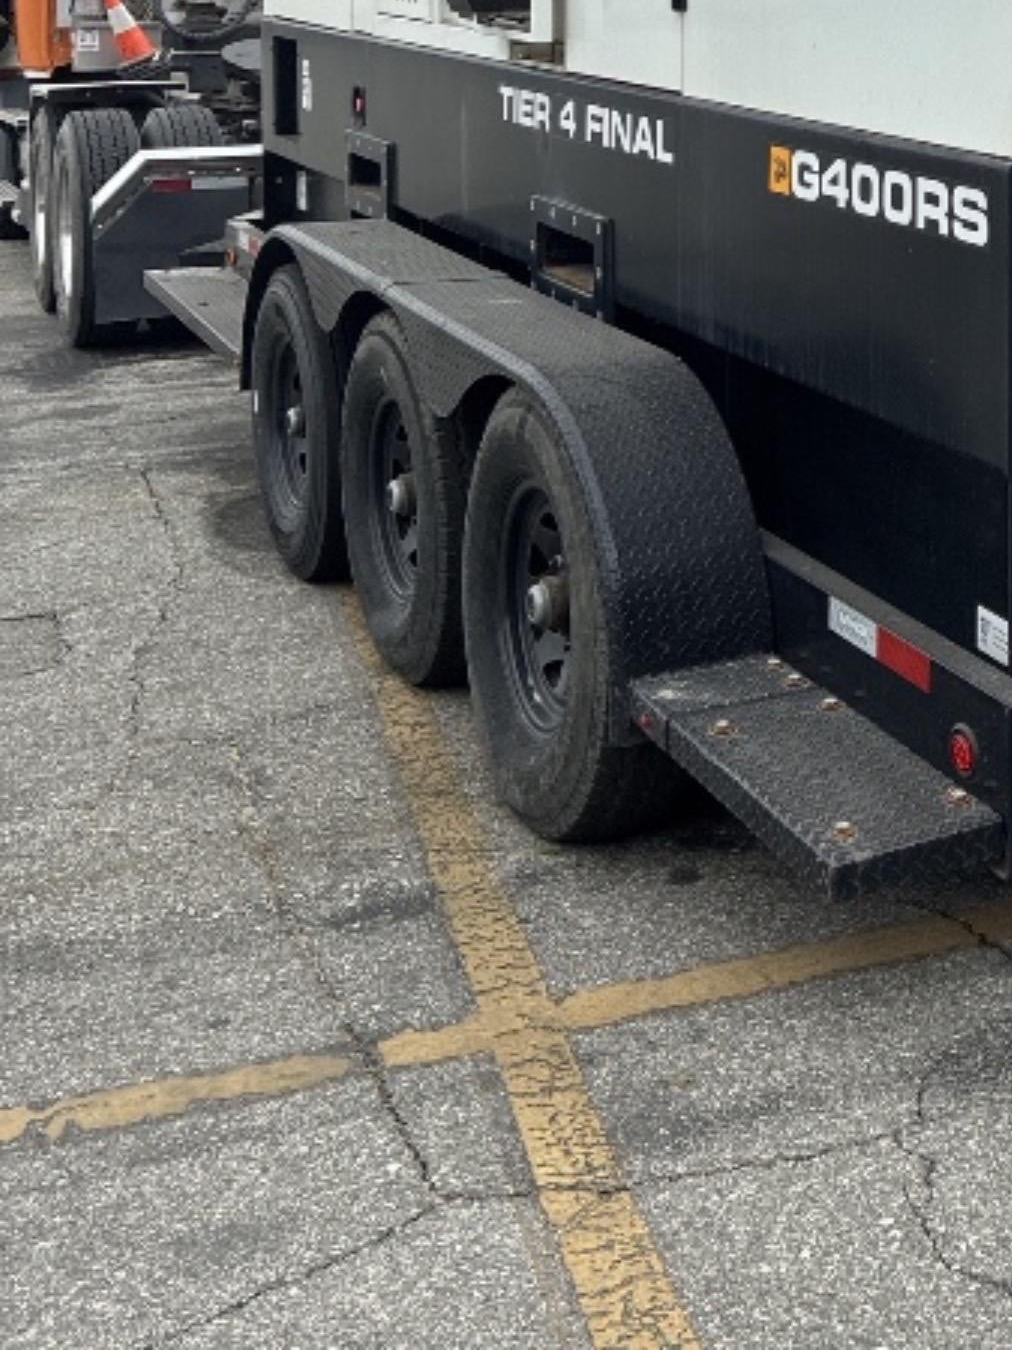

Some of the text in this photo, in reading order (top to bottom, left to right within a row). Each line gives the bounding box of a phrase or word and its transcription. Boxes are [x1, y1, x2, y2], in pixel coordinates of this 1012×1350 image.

[498, 85, 674, 164] TIER 4 FINAL
[791, 149, 988, 247] G400RS
